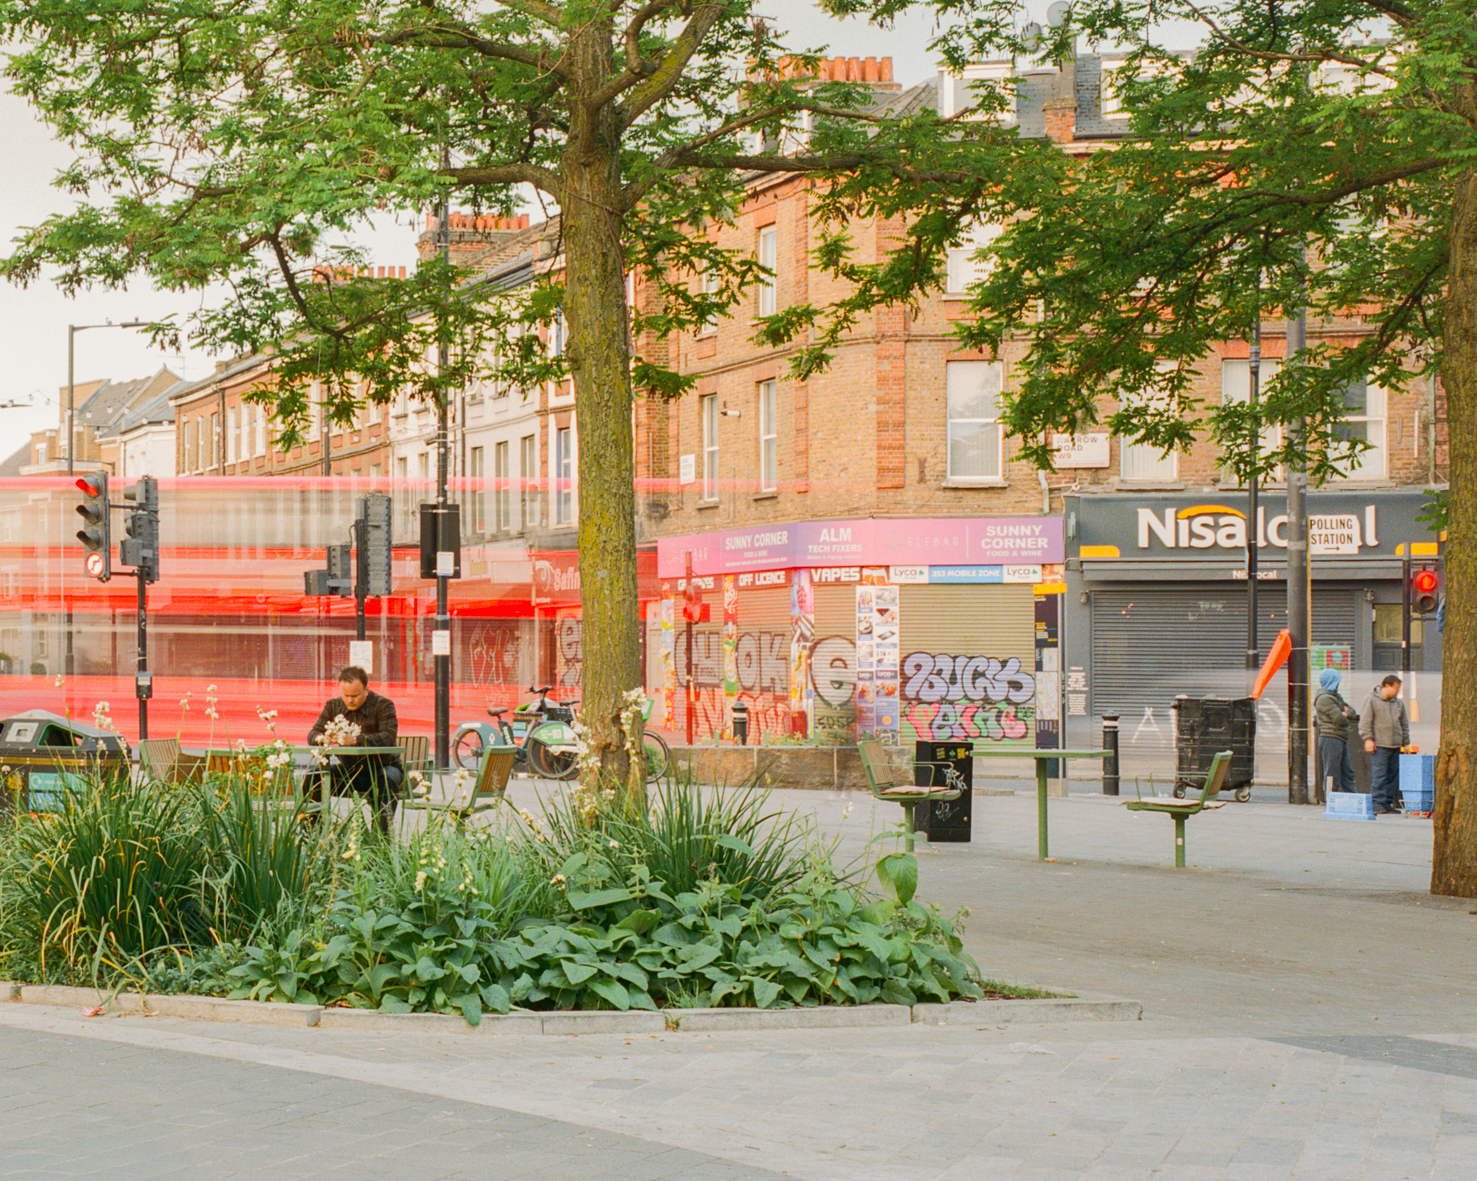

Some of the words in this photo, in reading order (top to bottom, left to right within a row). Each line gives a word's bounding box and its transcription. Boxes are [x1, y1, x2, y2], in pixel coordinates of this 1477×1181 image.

[1058, 452, 1071, 460] W9
[1310, 519, 1353, 530] POLLING
[819, 527, 852, 542] ALM
[986, 525, 1043, 537] SUNNY
[725, 533, 753, 551] SUNNY
[754, 530, 788, 548] CORNER
[907, 536, 959, 547] ELFBAR
[981, 537, 1049, 549] CORNER
[1310, 534, 1353, 545] STATION
[807, 544, 830, 553] TECH
[832, 543, 863, 552] FIXERS
[811, 567, 860, 582] VAPES
[894, 568, 917, 577] Lyca
[978, 569, 1000, 577] ZONE
[1007, 568, 1030, 576] Lyca
[738, 574, 753, 586] OFF
[755, 571, 786, 585] LICENCE
